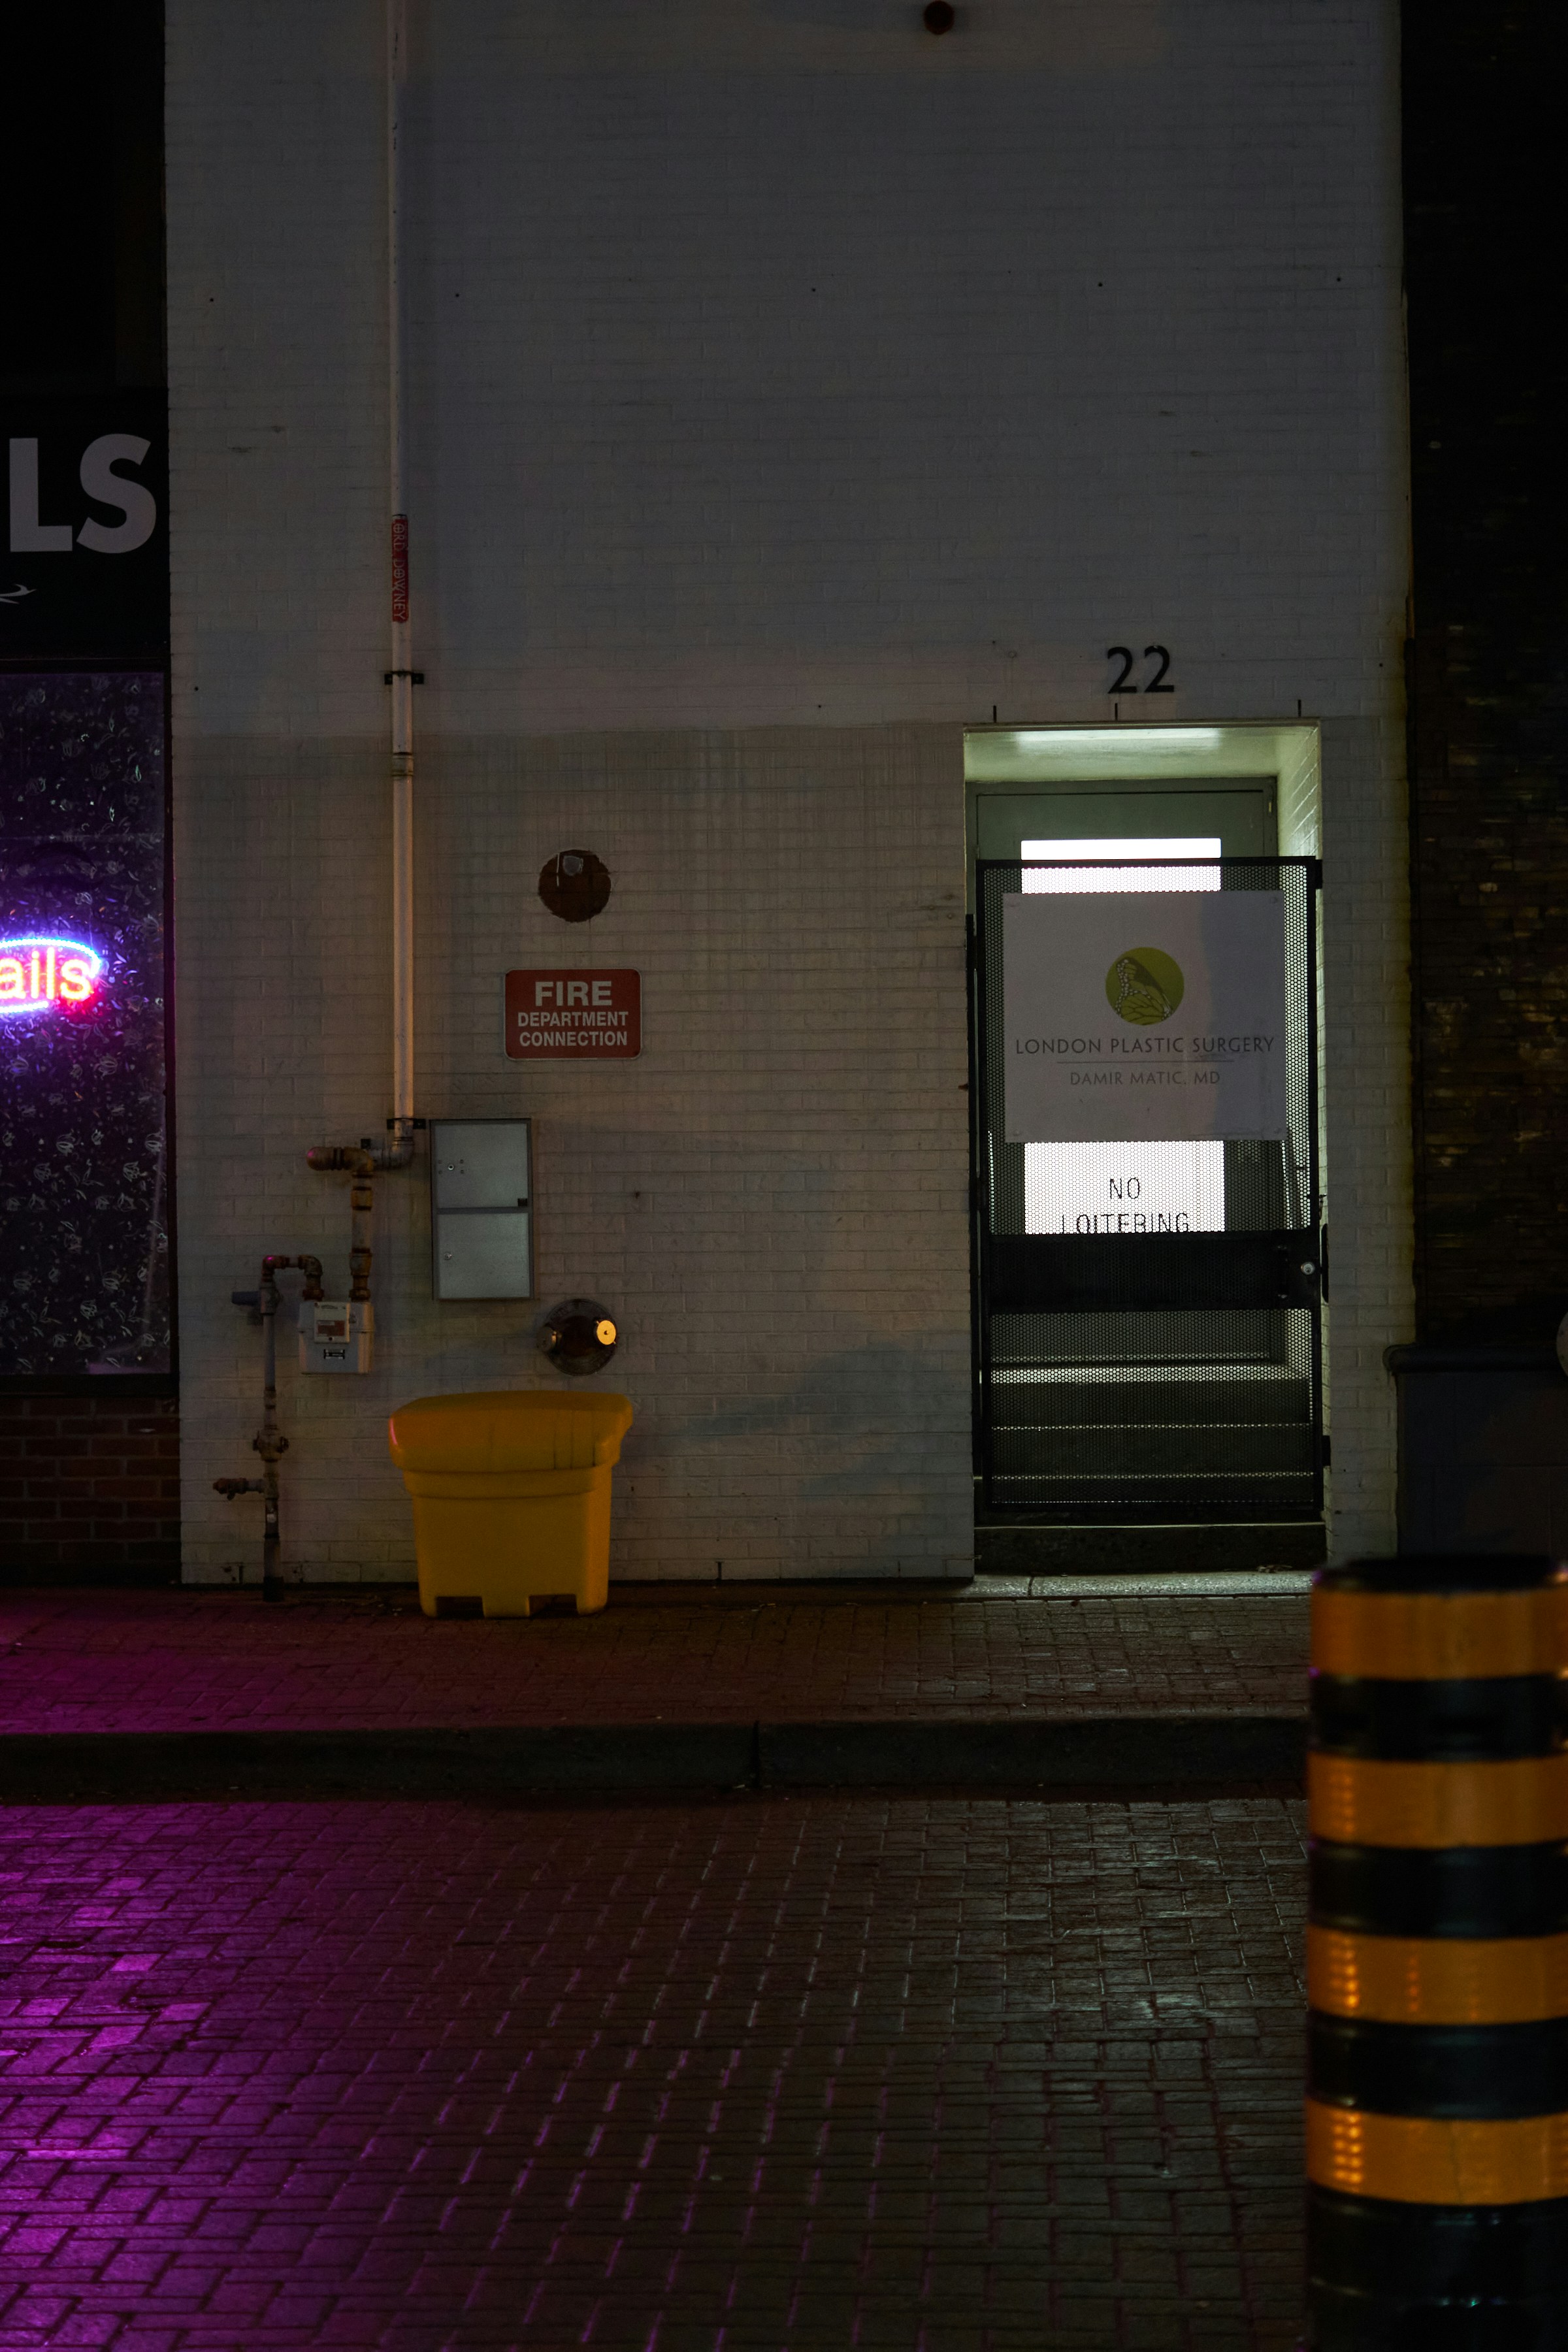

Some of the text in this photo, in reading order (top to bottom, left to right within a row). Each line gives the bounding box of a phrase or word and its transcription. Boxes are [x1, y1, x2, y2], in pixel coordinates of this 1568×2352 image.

[9, 433, 157, 554] LS
[393, 559, 406, 620] DOWNEY
[1107, 645, 1174, 693] 22
[0, 947, 91, 1000] ails
[535, 981, 612, 1007] FIRE
[518, 1011, 629, 1027] DEPARTMENT
[519, 1031, 627, 1047] CONNECTION
[1016, 1037, 1274, 1054] LONDON PLASTIC SURGERY
[1070, 1072, 1122, 1085] DAMIR
[1194, 1071, 1220, 1085] MD
[1110, 1177, 1140, 1200] NO
